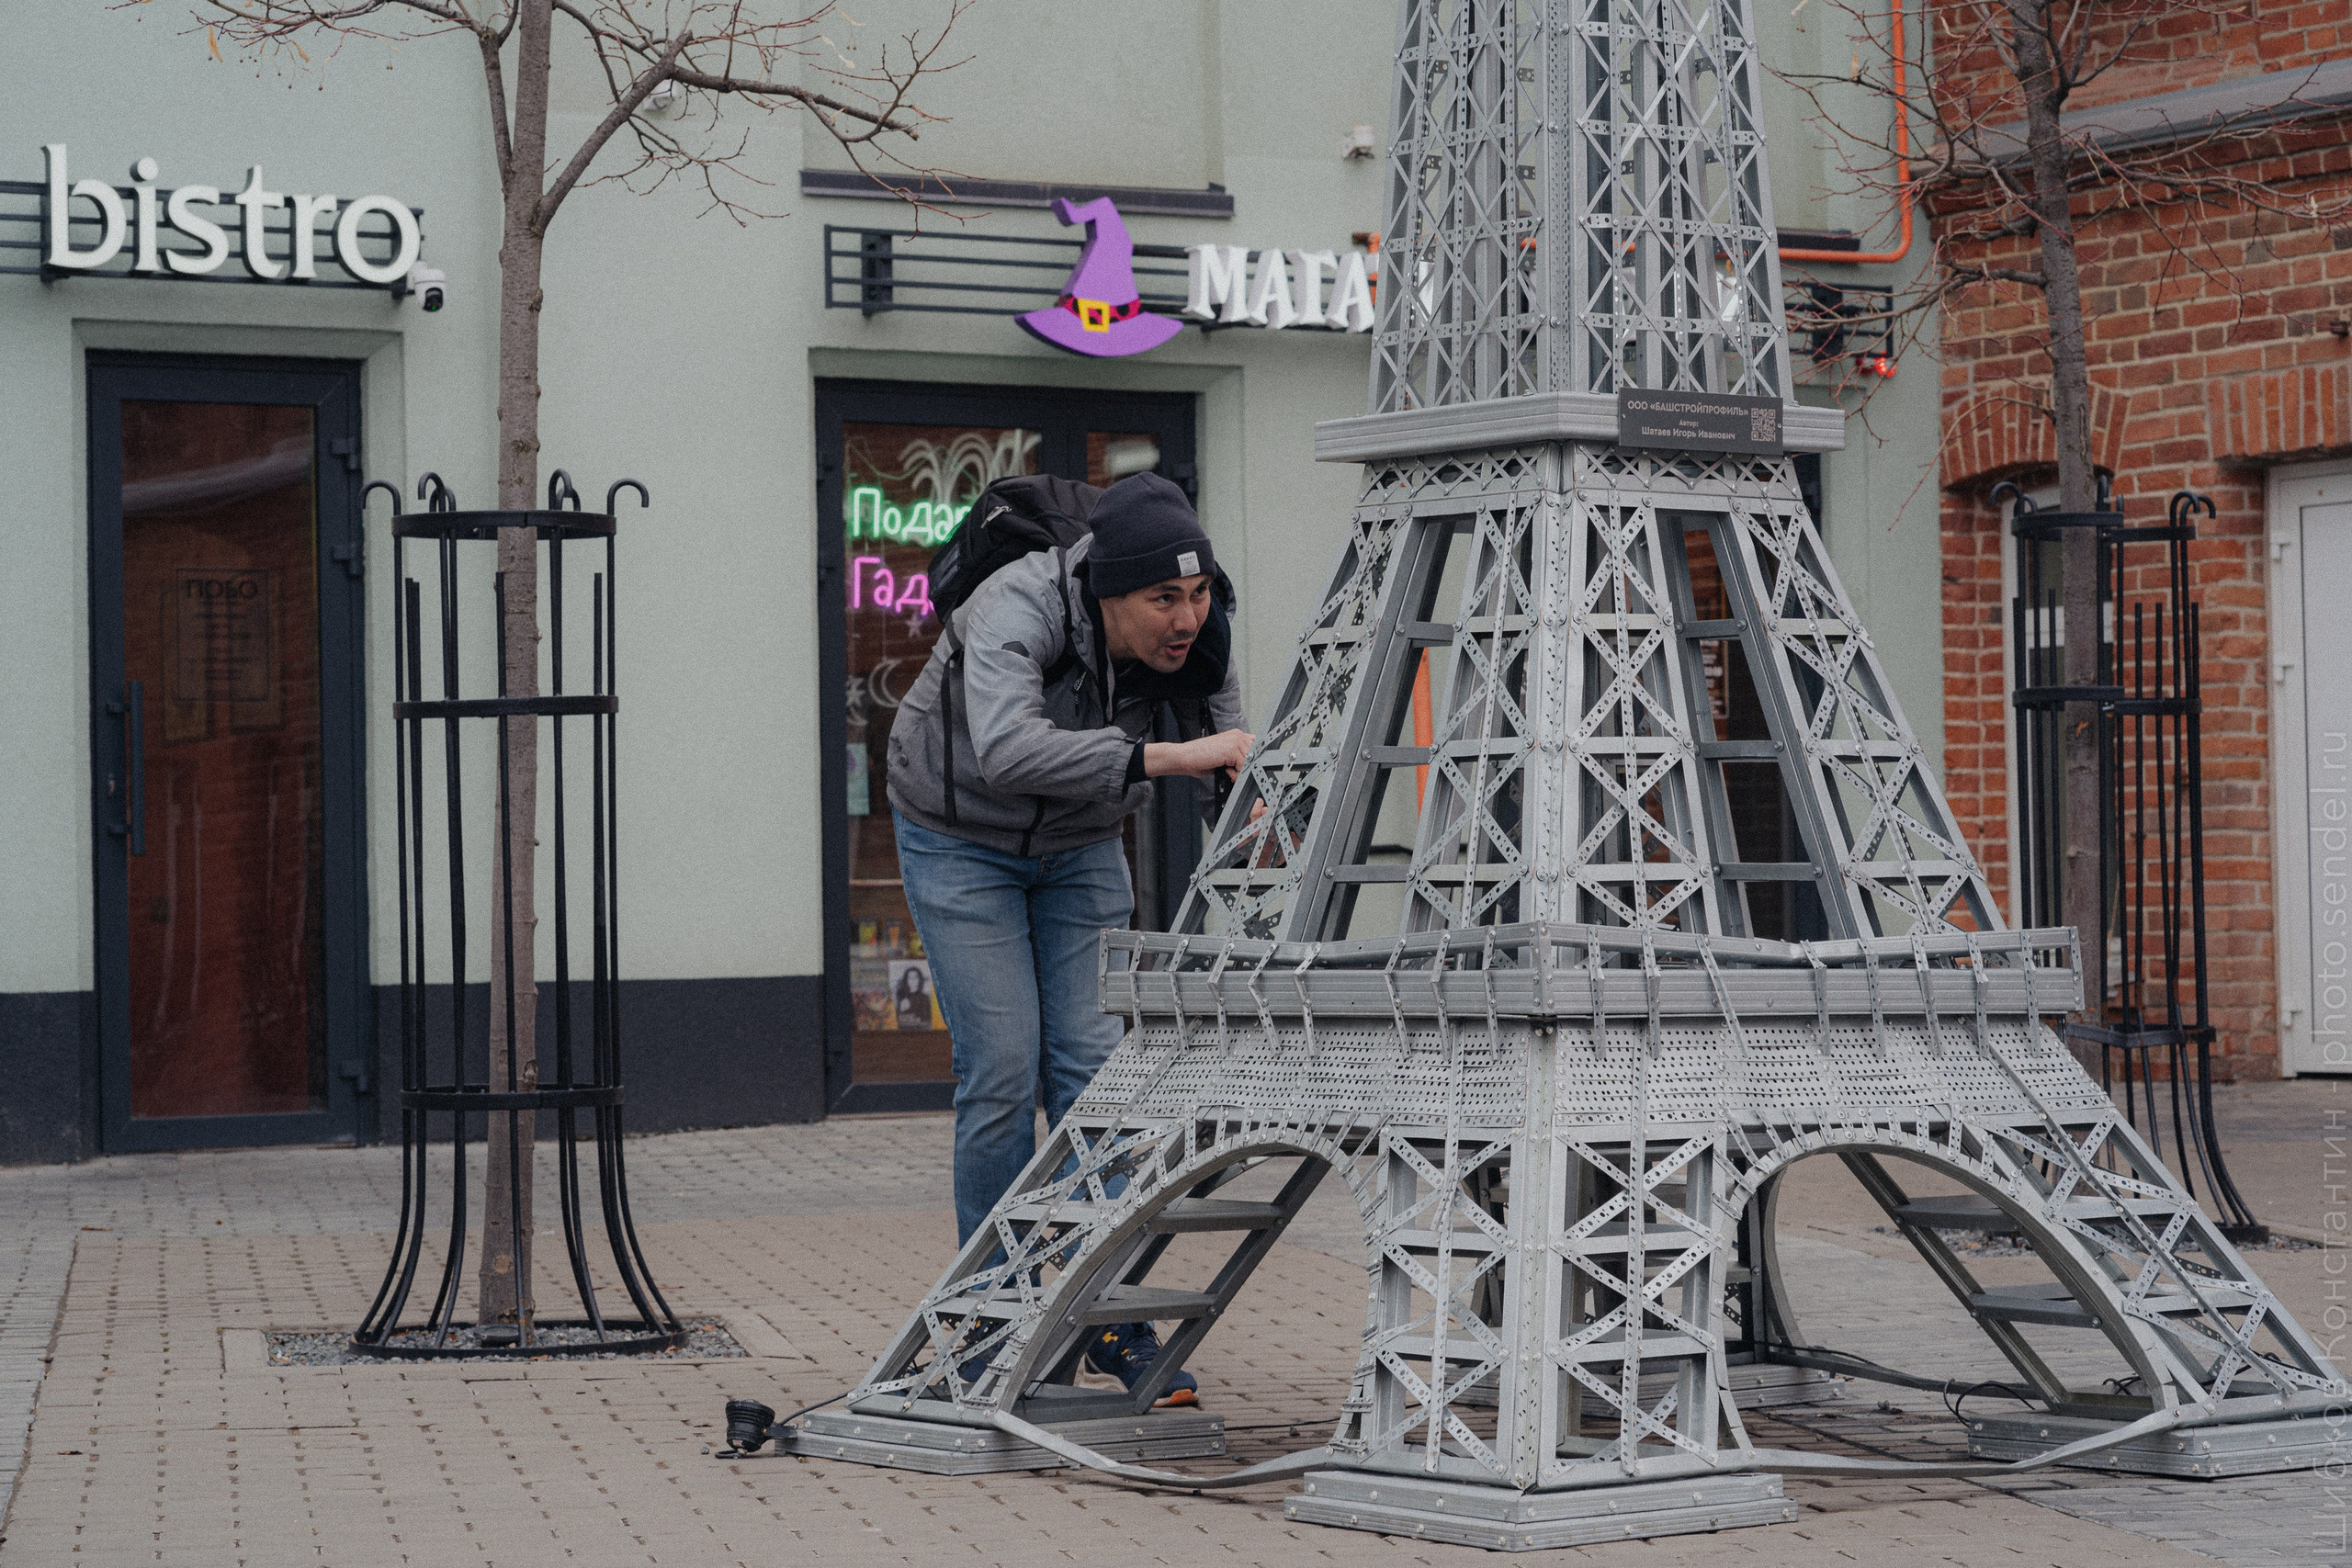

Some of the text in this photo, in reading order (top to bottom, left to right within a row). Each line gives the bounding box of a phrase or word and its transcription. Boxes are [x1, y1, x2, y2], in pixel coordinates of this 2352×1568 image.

[41, 142, 421, 284] bistro
[1182, 243, 1376, 333] МАГА
[1627, 400, 1748, 416] ООО «БАШСТРОЙПРОФИЛЬ»
[1679, 419, 1699, 429] Автор:
[1641, 425, 1736, 440] Шатаев Игорь Иванович
[853, 556, 935, 616] Гад
